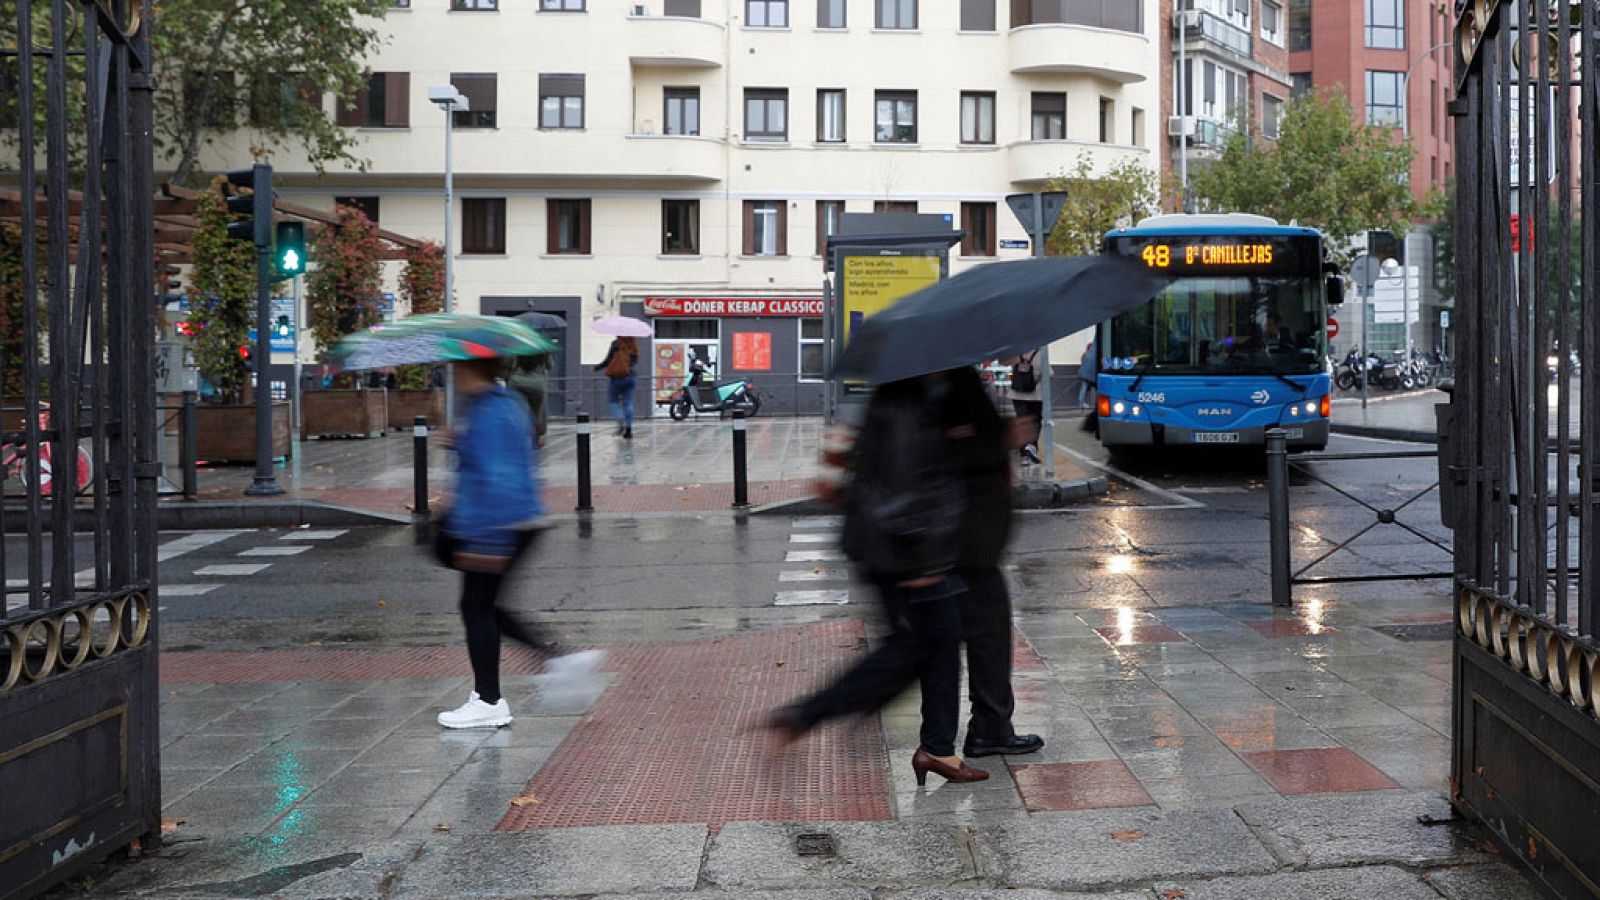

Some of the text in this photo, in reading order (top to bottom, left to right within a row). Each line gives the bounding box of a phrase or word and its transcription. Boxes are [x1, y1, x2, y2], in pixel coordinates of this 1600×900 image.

[1142, 245, 1170, 267] 48
[1202, 245, 1273, 264] CANILLEJAS
[727, 301, 765, 313] KEBAP
[769, 301, 824, 313] CLASSICO
[1138, 392, 1165, 403] 5246
